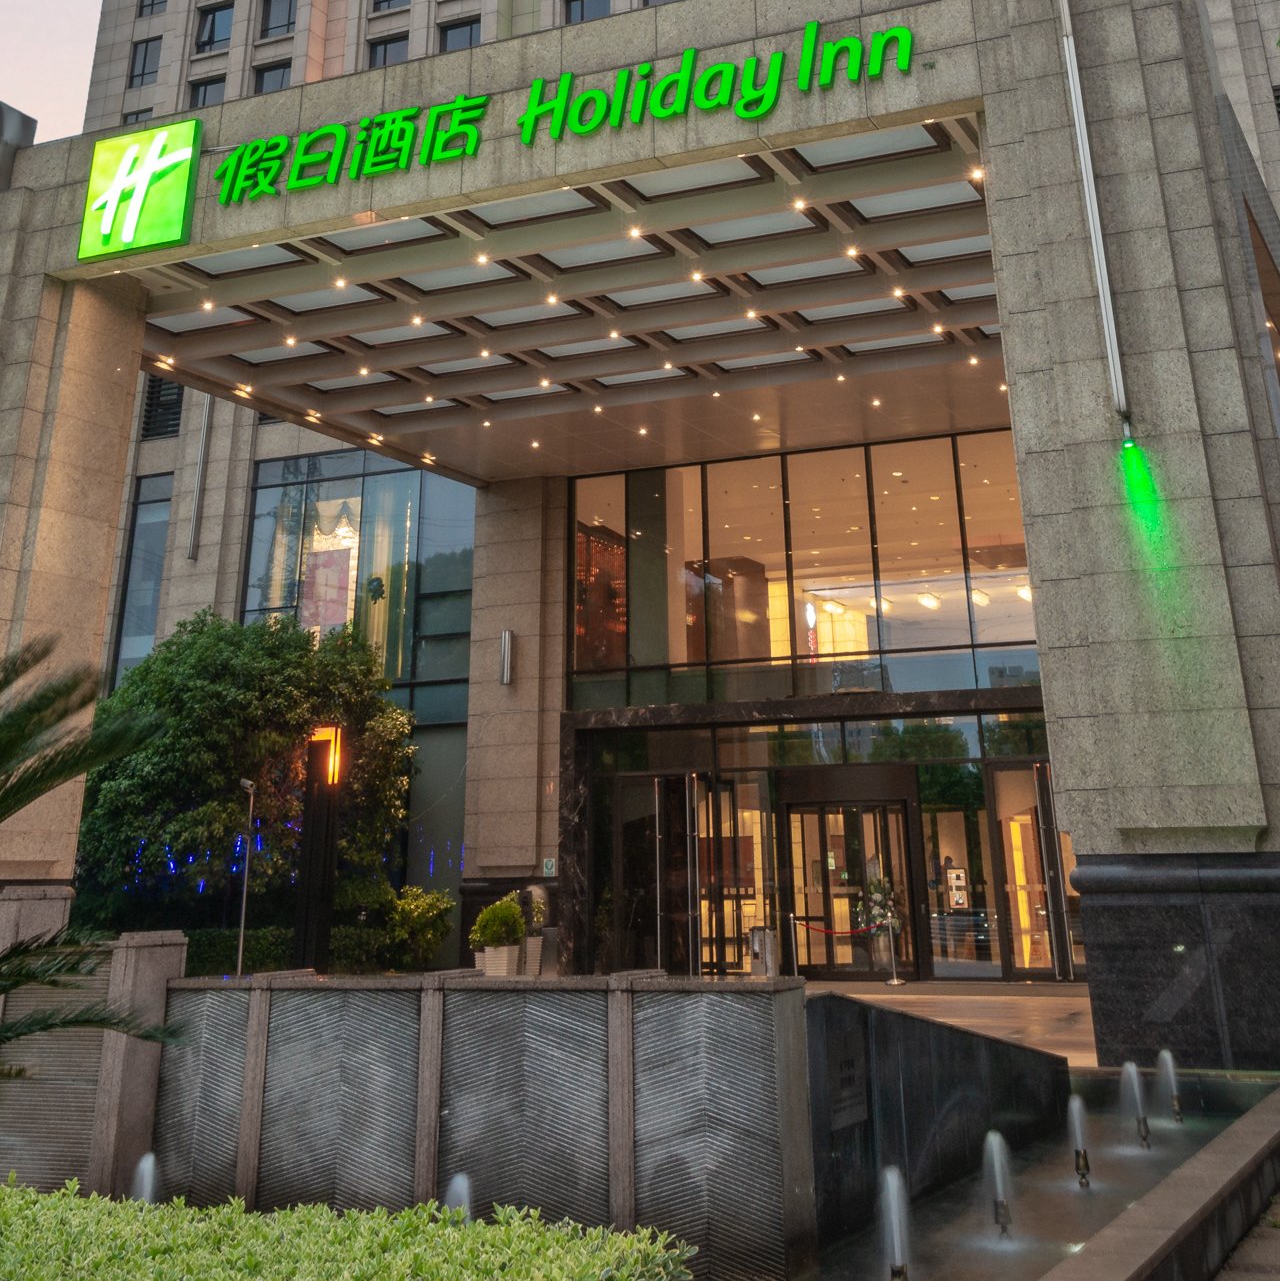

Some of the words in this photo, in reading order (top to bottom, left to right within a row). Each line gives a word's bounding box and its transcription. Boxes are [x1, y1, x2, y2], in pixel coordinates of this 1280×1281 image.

[516, 47, 784, 147] Holiday
[796, 20, 914, 93] Inn
[213, 94, 490, 207] 假日酒店
